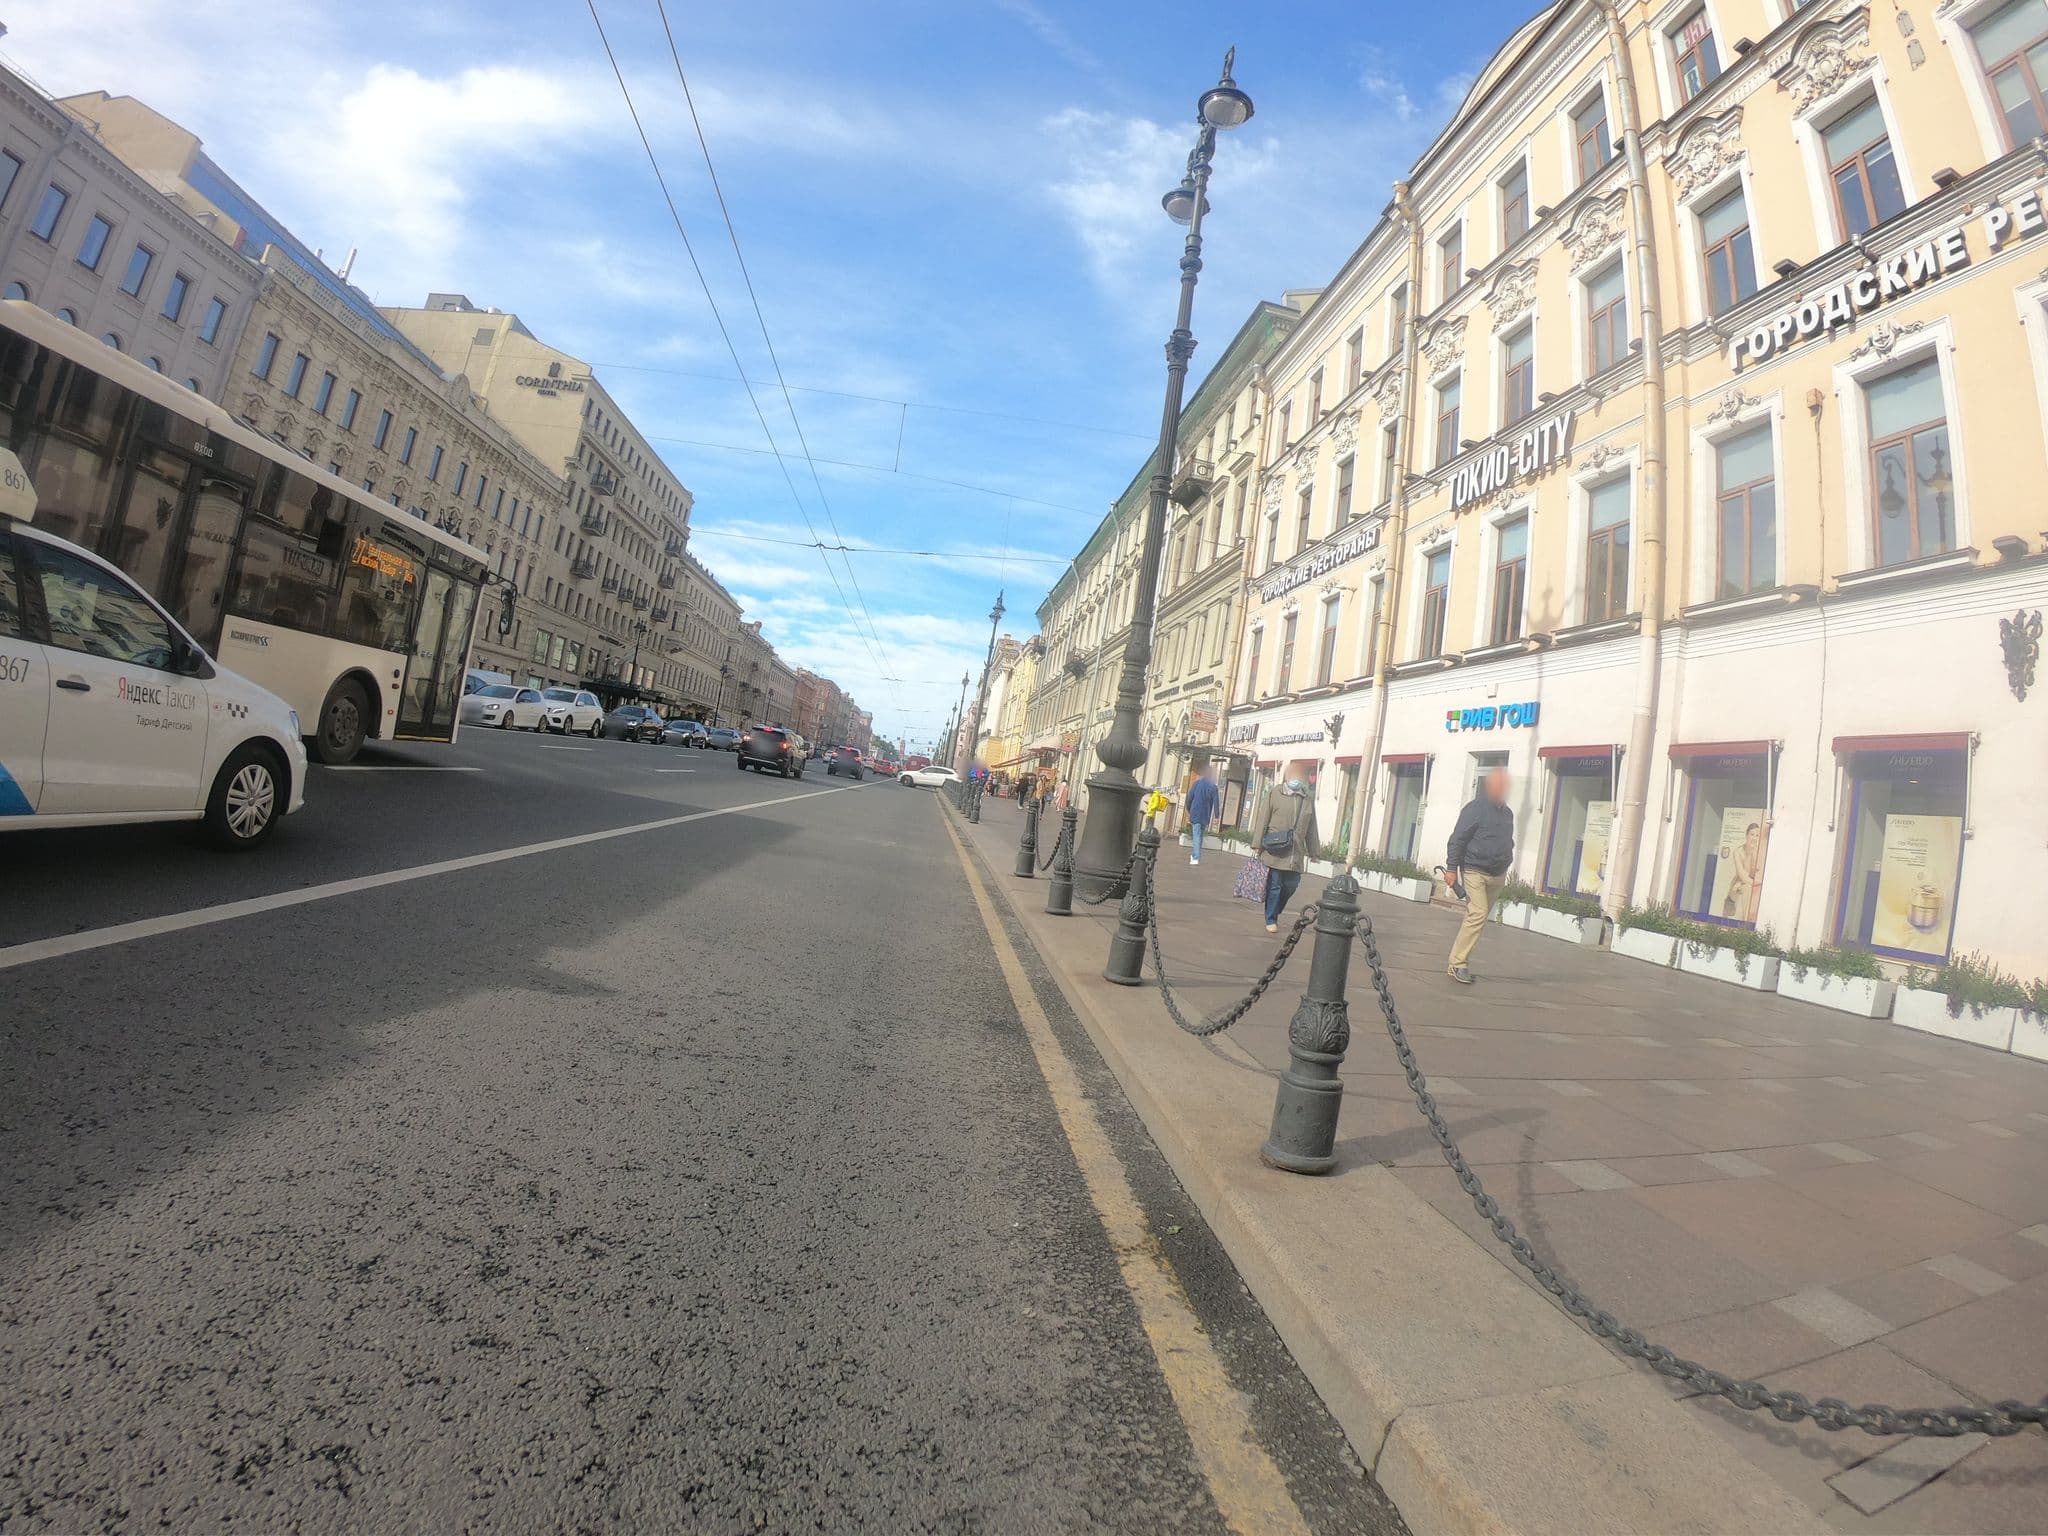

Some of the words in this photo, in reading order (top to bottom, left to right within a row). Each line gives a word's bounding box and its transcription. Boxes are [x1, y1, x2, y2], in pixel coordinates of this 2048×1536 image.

[1729, 227, 1970, 373] ГОРОДСКИЕ
[1983, 187, 2048, 251] РЕ
[515, 375, 584, 392] CORINTHIA
[194, 442, 214, 458] ВХОД
[5, 468, 26, 492] 867
[1260, 564, 1312, 604] ГОРОДСКИЕ
[1311, 528, 1379, 579] РЕСТОРАНЫ
[0, 655, 29, 683] 867
[118, 676, 161, 705] Яндекс
[165, 685, 196, 710] Такси
[136, 714, 160, 729] Тариф
[161, 718, 193, 731] Детский
[1461, 707, 1497, 731] РИВ
[1498, 701, 1540, 729] ГОШ
